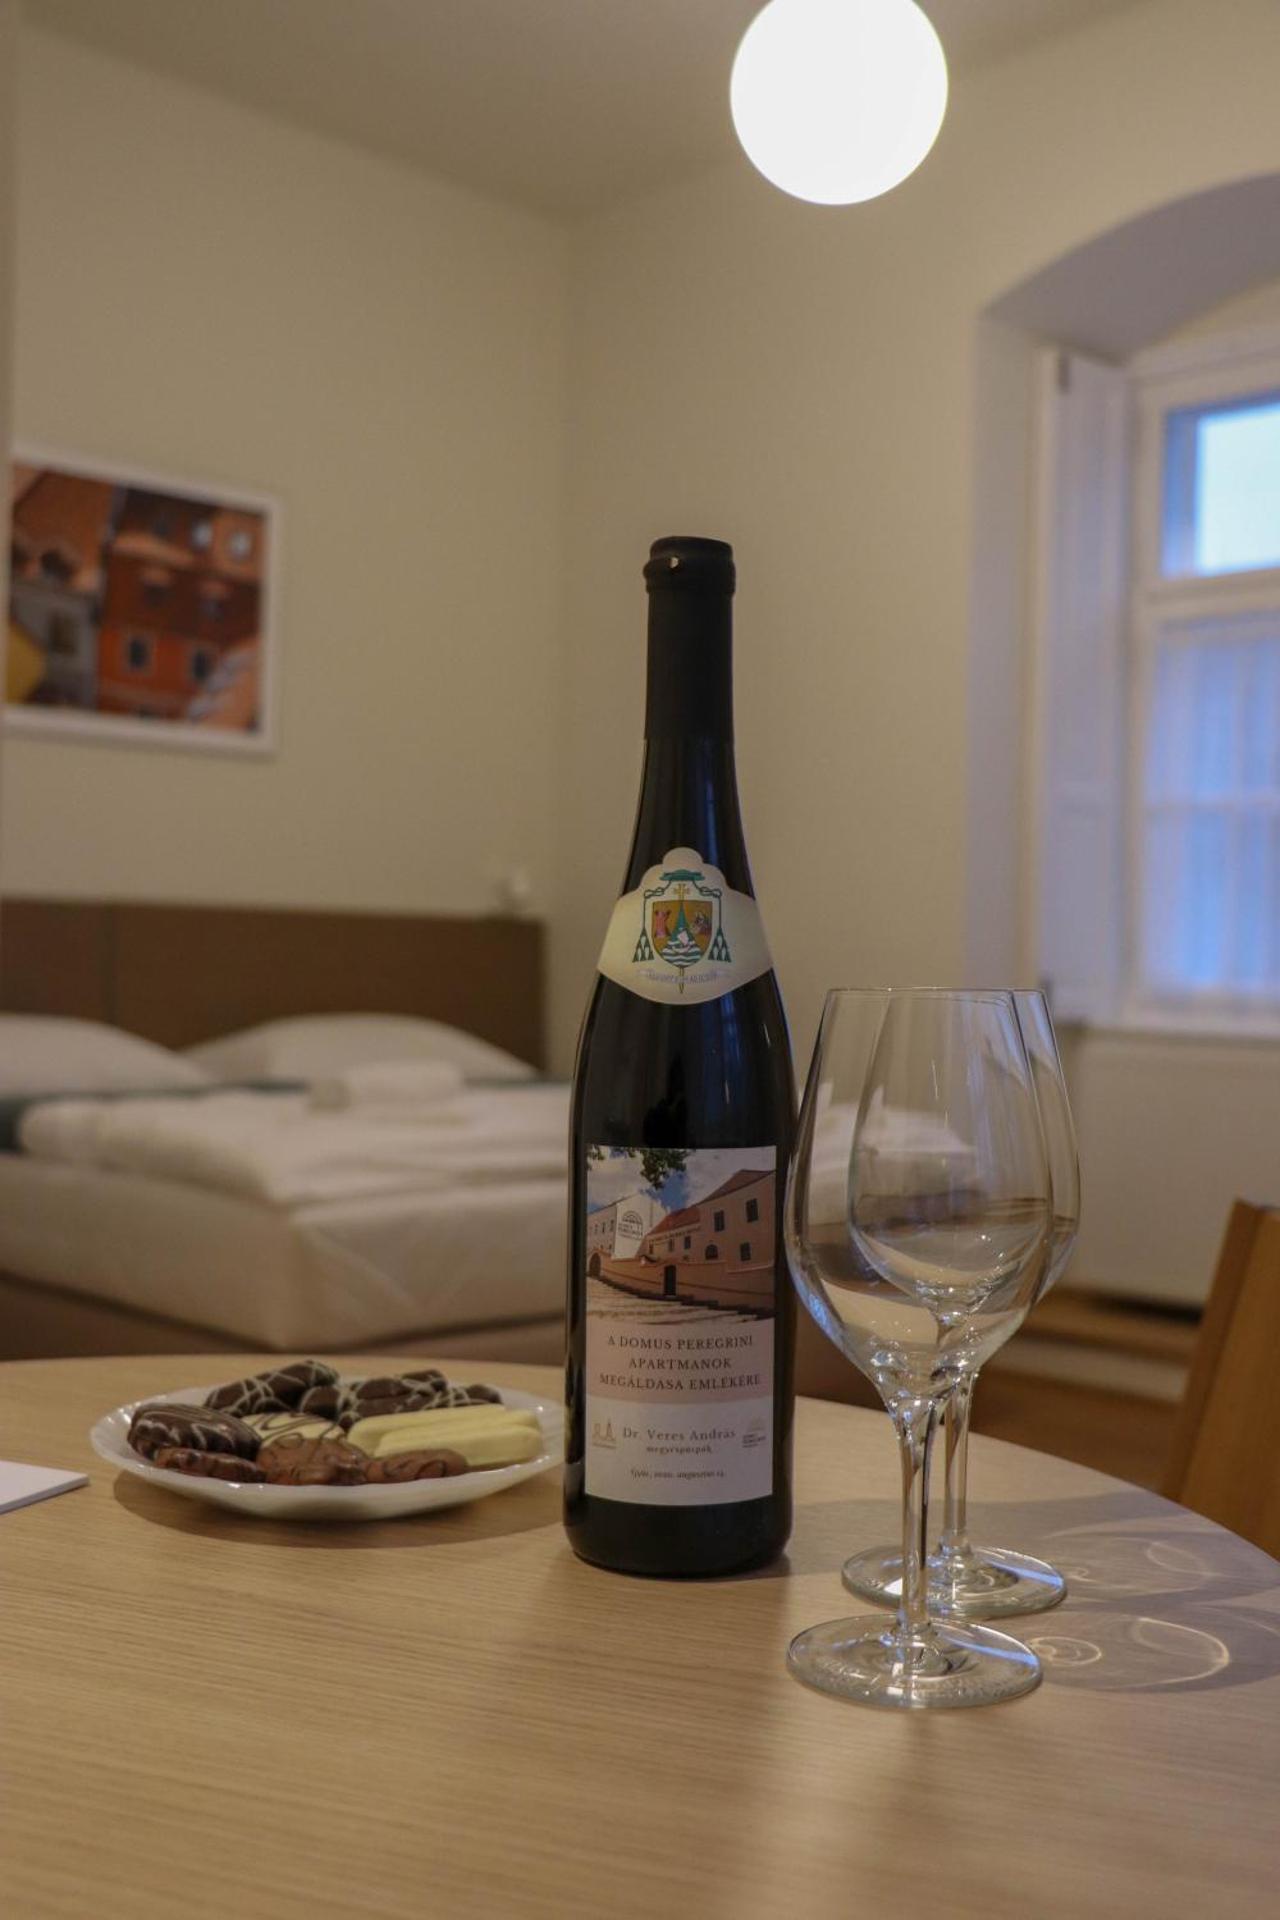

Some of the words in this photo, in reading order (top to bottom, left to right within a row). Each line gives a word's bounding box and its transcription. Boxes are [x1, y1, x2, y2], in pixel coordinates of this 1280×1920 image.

[608, 1335, 615, 1345] A
[620, 1335, 672, 1350] DOMUS
[677, 1335, 753, 1350] PEREGRINI
[629, 1358, 731, 1370] APARTMANOK
[647, 1428, 685, 1440] Veres
